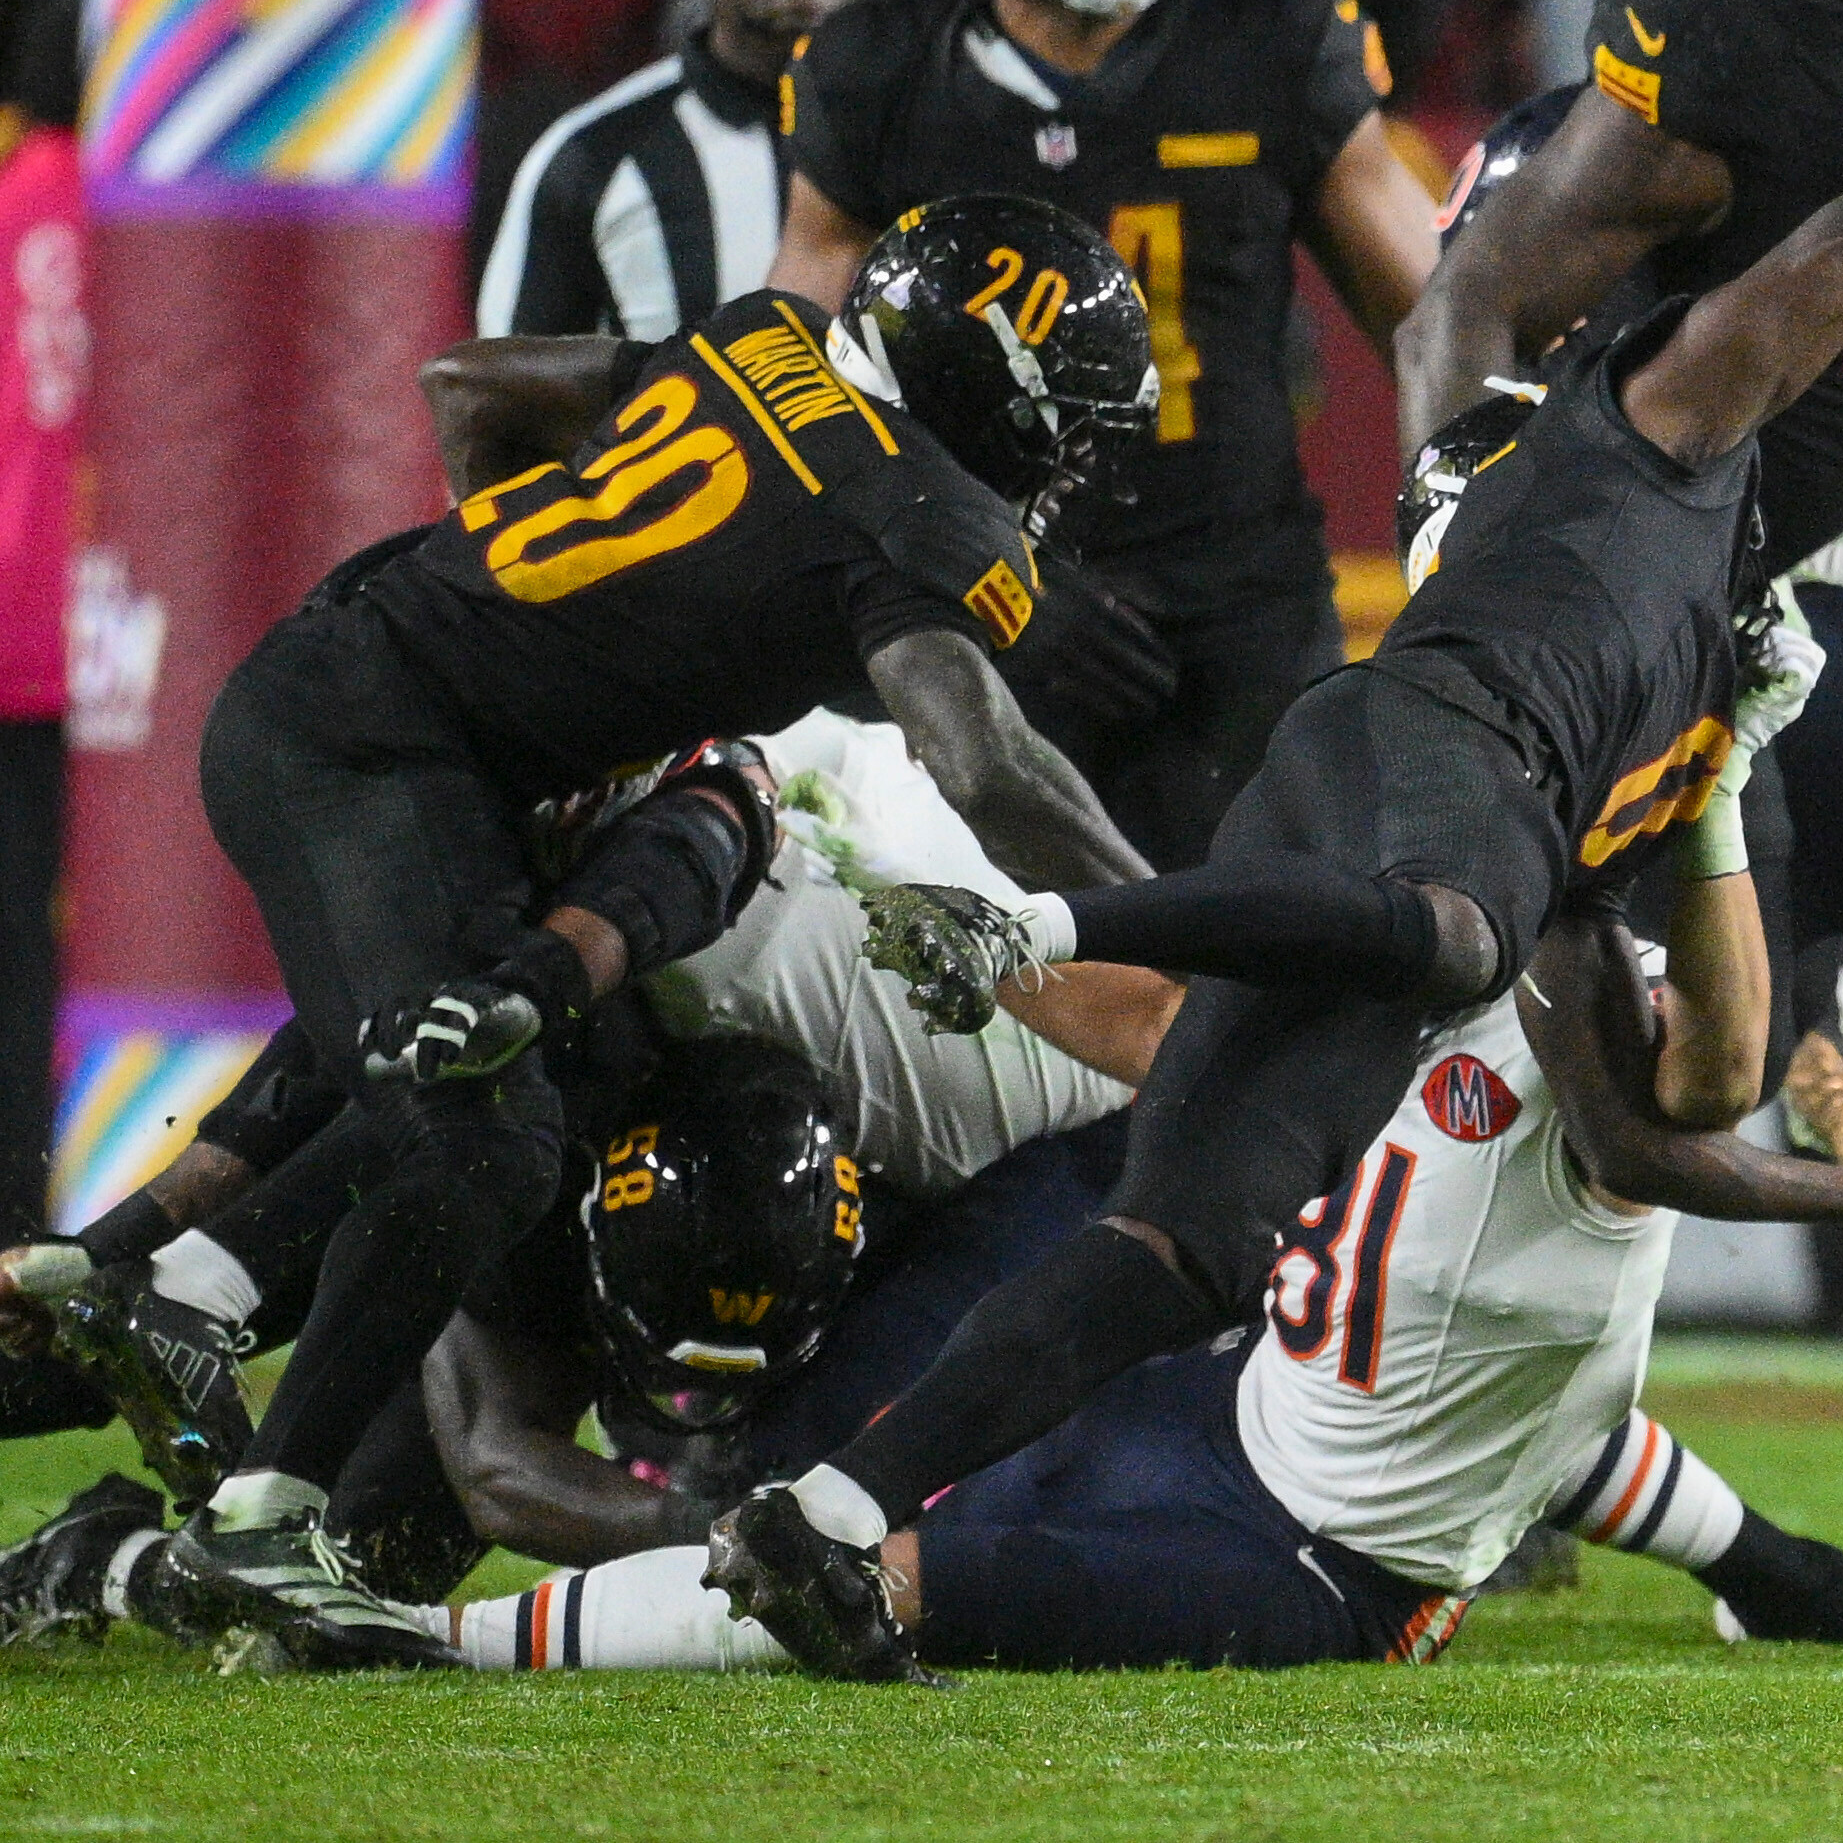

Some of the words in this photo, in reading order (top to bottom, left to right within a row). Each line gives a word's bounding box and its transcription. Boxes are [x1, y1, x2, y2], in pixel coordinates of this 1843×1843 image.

[963, 245, 1070, 347] 20
[722, 325, 857, 433] MARTIN
[457, 371, 753, 604] 20
[1446, 1060, 1492, 1137] M
[707, 1287, 775, 1326] W
[1267, 1140, 1419, 1396] 81
